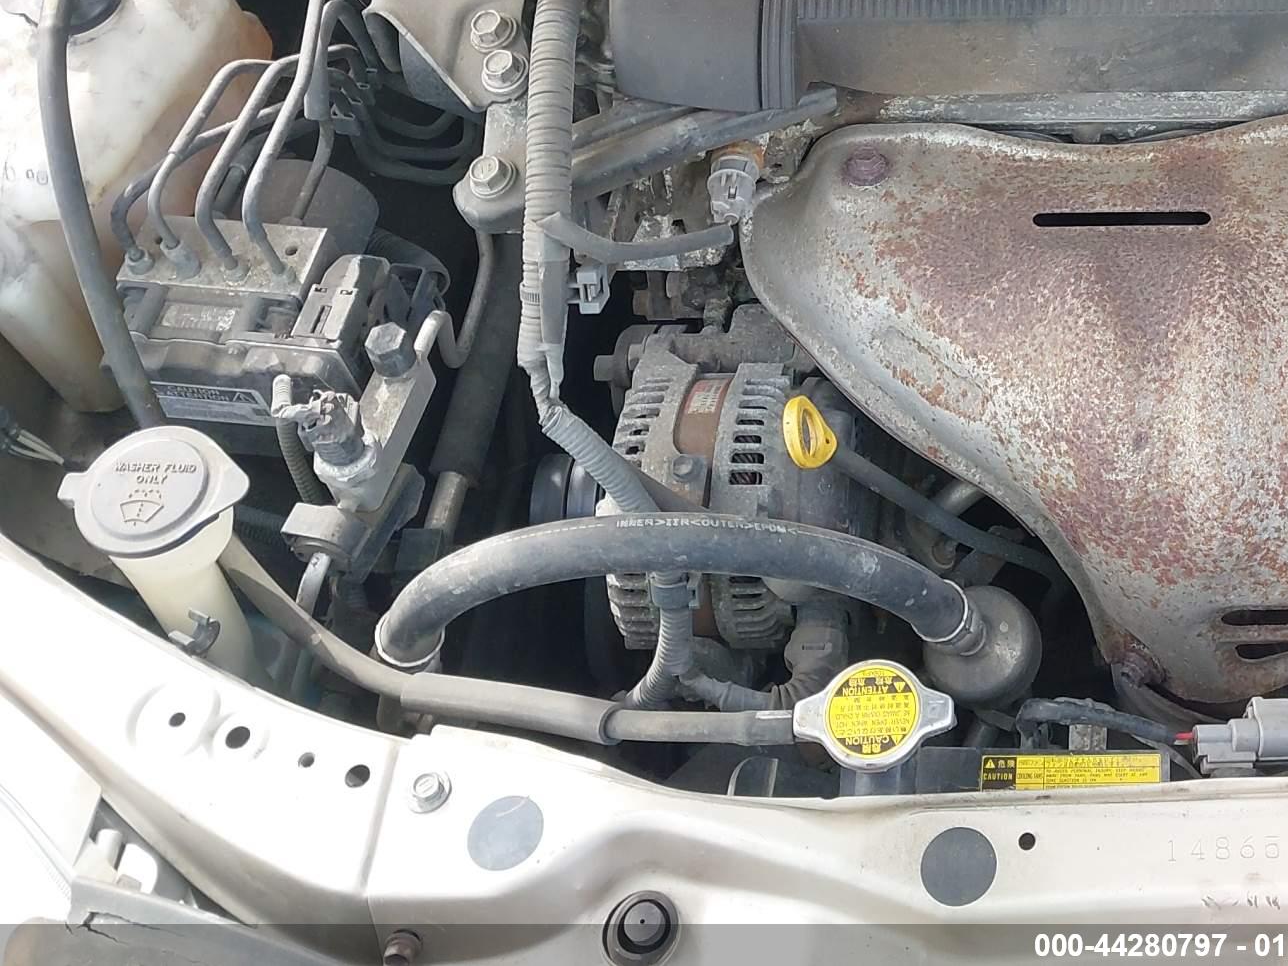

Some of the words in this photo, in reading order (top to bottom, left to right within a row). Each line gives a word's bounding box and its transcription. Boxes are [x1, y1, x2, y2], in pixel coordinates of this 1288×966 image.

[116, 462, 161, 473] WASHER
[164, 464, 197, 474] FLUID
[137, 475, 168, 485] ONLY
[842, 685, 889, 697] ATTENTION
[845, 735, 890, 746] CAUTION
[983, 772, 1013, 781] CAUTION
